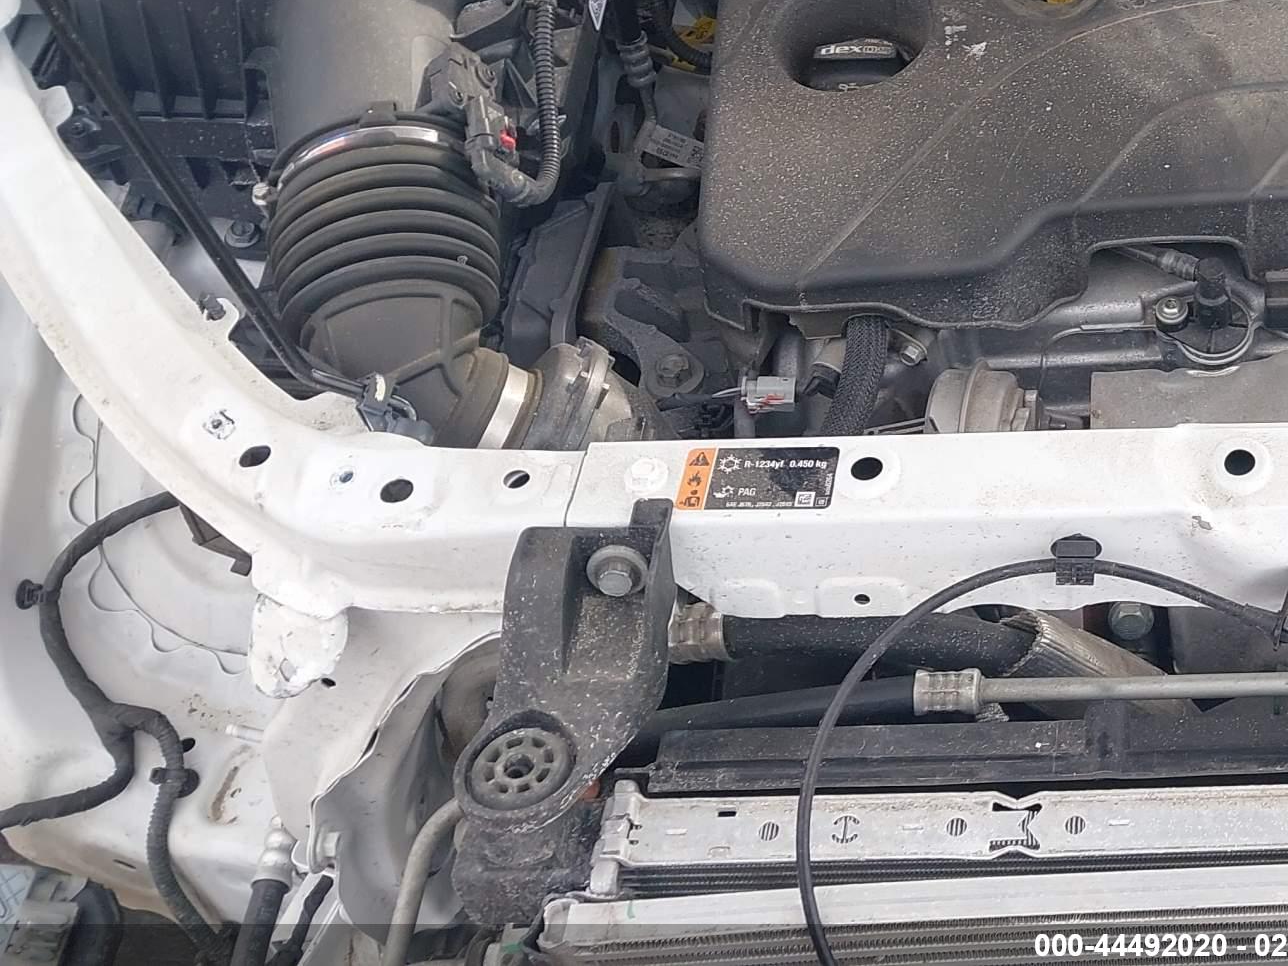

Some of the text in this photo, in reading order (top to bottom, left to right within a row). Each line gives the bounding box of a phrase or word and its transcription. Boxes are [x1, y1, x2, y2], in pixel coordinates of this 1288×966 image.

[743, 459, 828, 470] R-1234yf 0.450 kg
[737, 487, 756, 497] PAG
